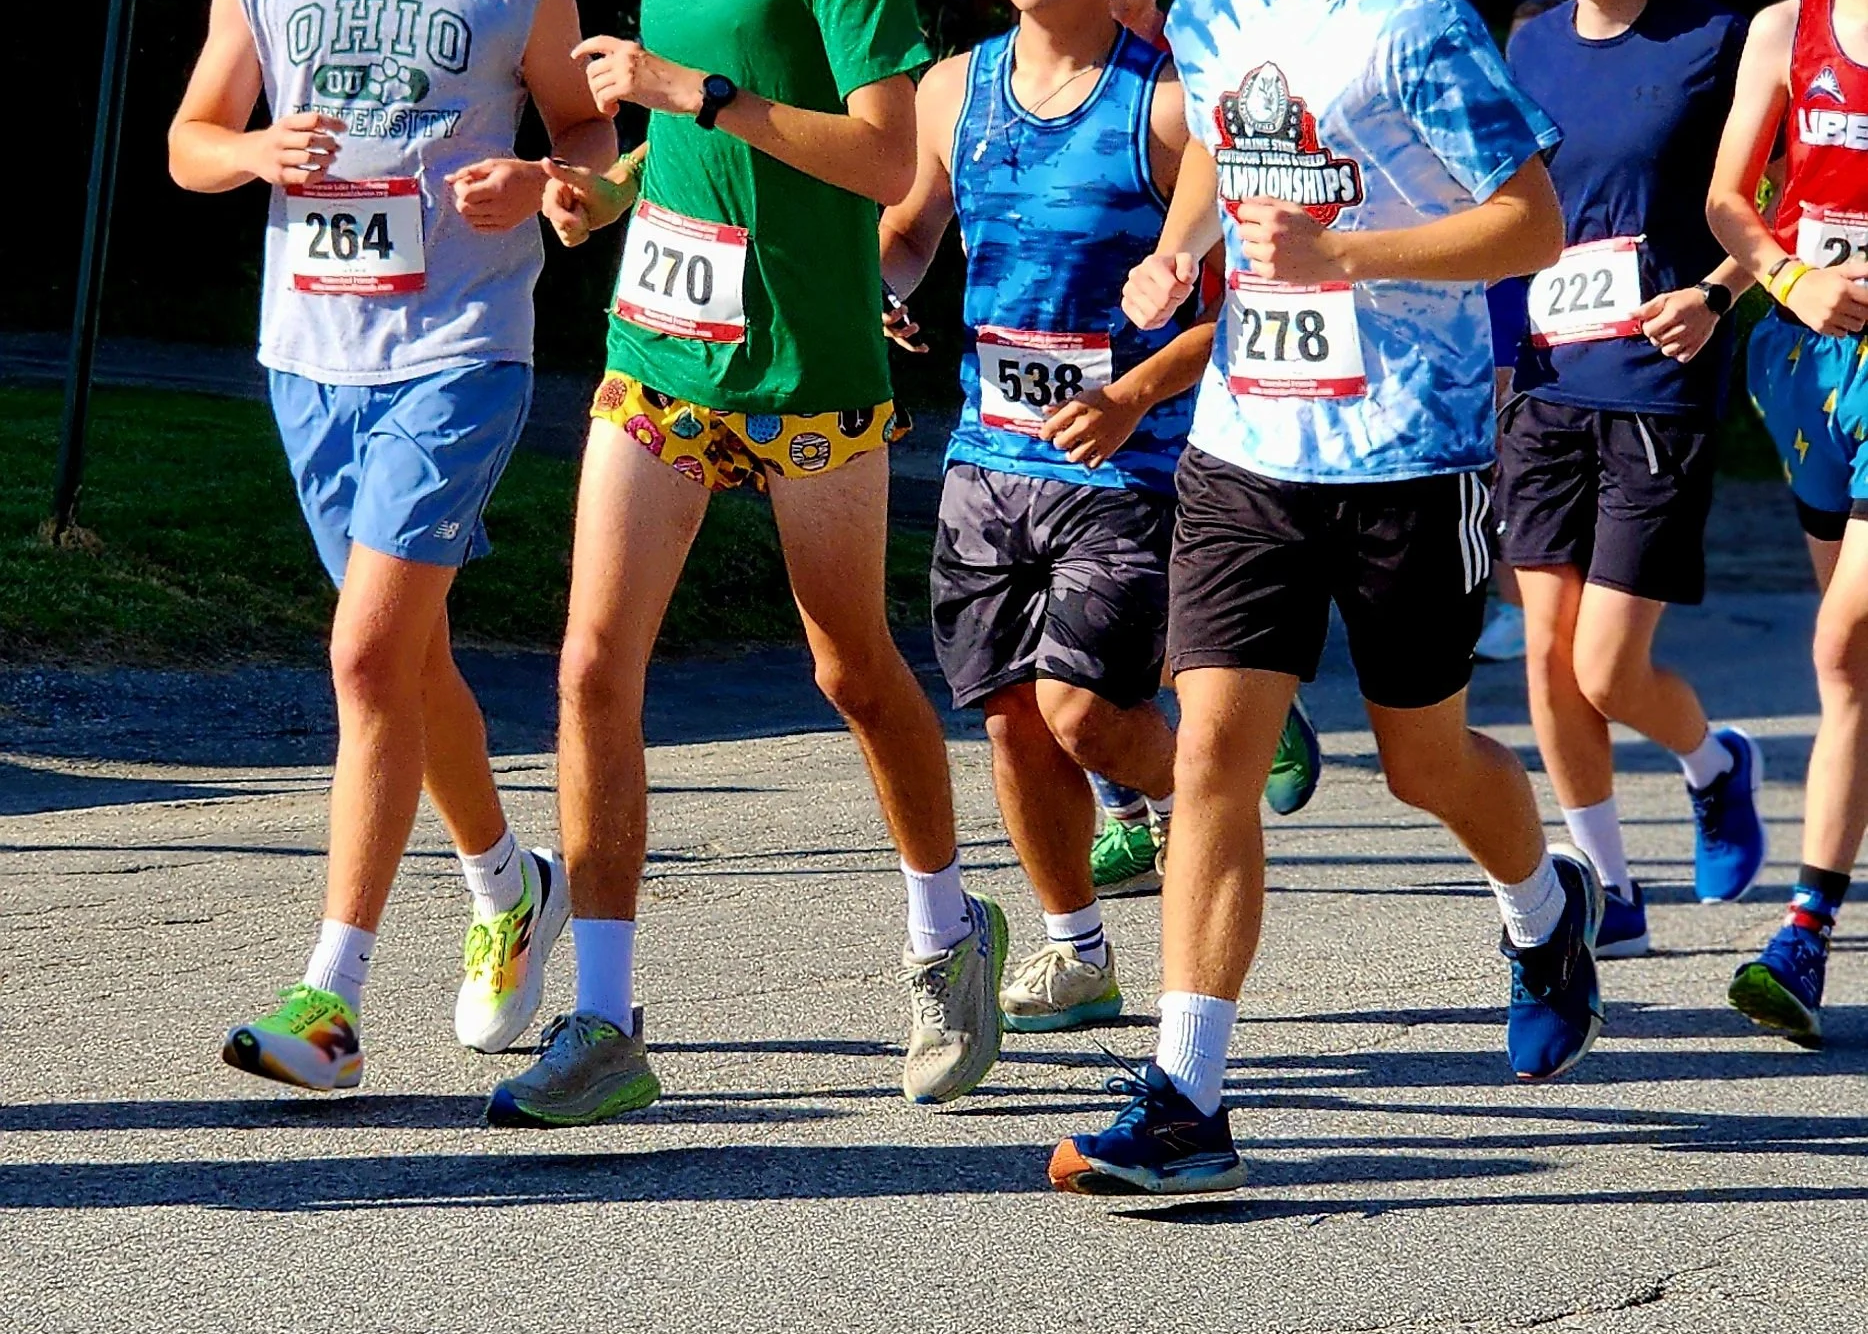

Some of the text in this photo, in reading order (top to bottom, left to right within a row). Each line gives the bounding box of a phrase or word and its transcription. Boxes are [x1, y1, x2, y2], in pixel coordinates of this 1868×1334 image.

[325, 70, 363, 94] OU
[292, 104, 461, 139] VERSITY
[1217, 149, 1260, 164] OUTDOOR
[1261, 153, 1290, 165] TRACK
[1298, 154, 1327, 167] FIELD
[1234, 137, 1270, 151] MAINE
[1218, 164, 1355, 204] AMPIONSHIPS
[305, 212, 394, 260] 264
[1823, 237, 1868, 269] 2
[638, 239, 714, 306] 270
[1548, 268, 1615, 317] 222
[1241, 308, 1329, 362] 278
[998, 359, 1084, 407] 538
